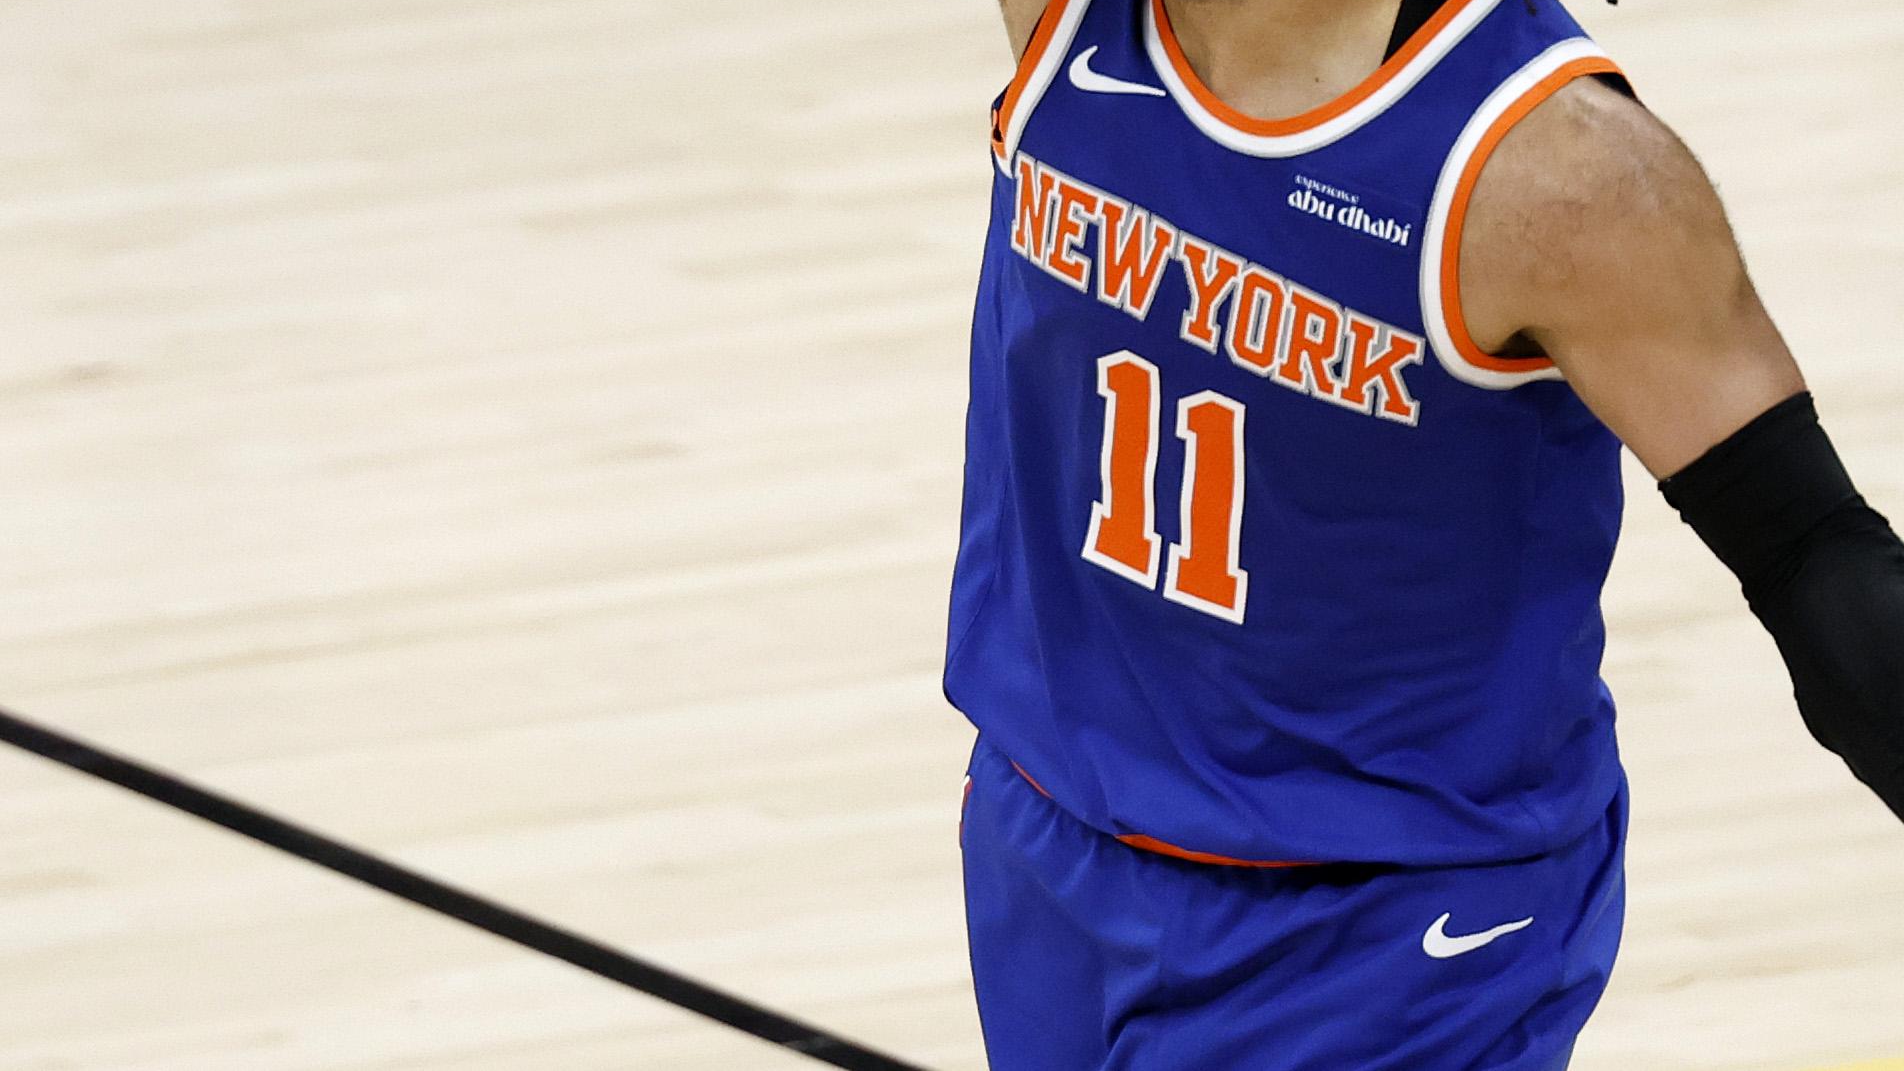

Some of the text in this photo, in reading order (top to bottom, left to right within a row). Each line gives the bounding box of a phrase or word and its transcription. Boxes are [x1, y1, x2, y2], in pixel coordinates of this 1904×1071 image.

[1011, 149, 1426, 427] NEW YORK
[1287, 189, 1412, 246] abu dhabi
[1081, 349, 1249, 625] 11
